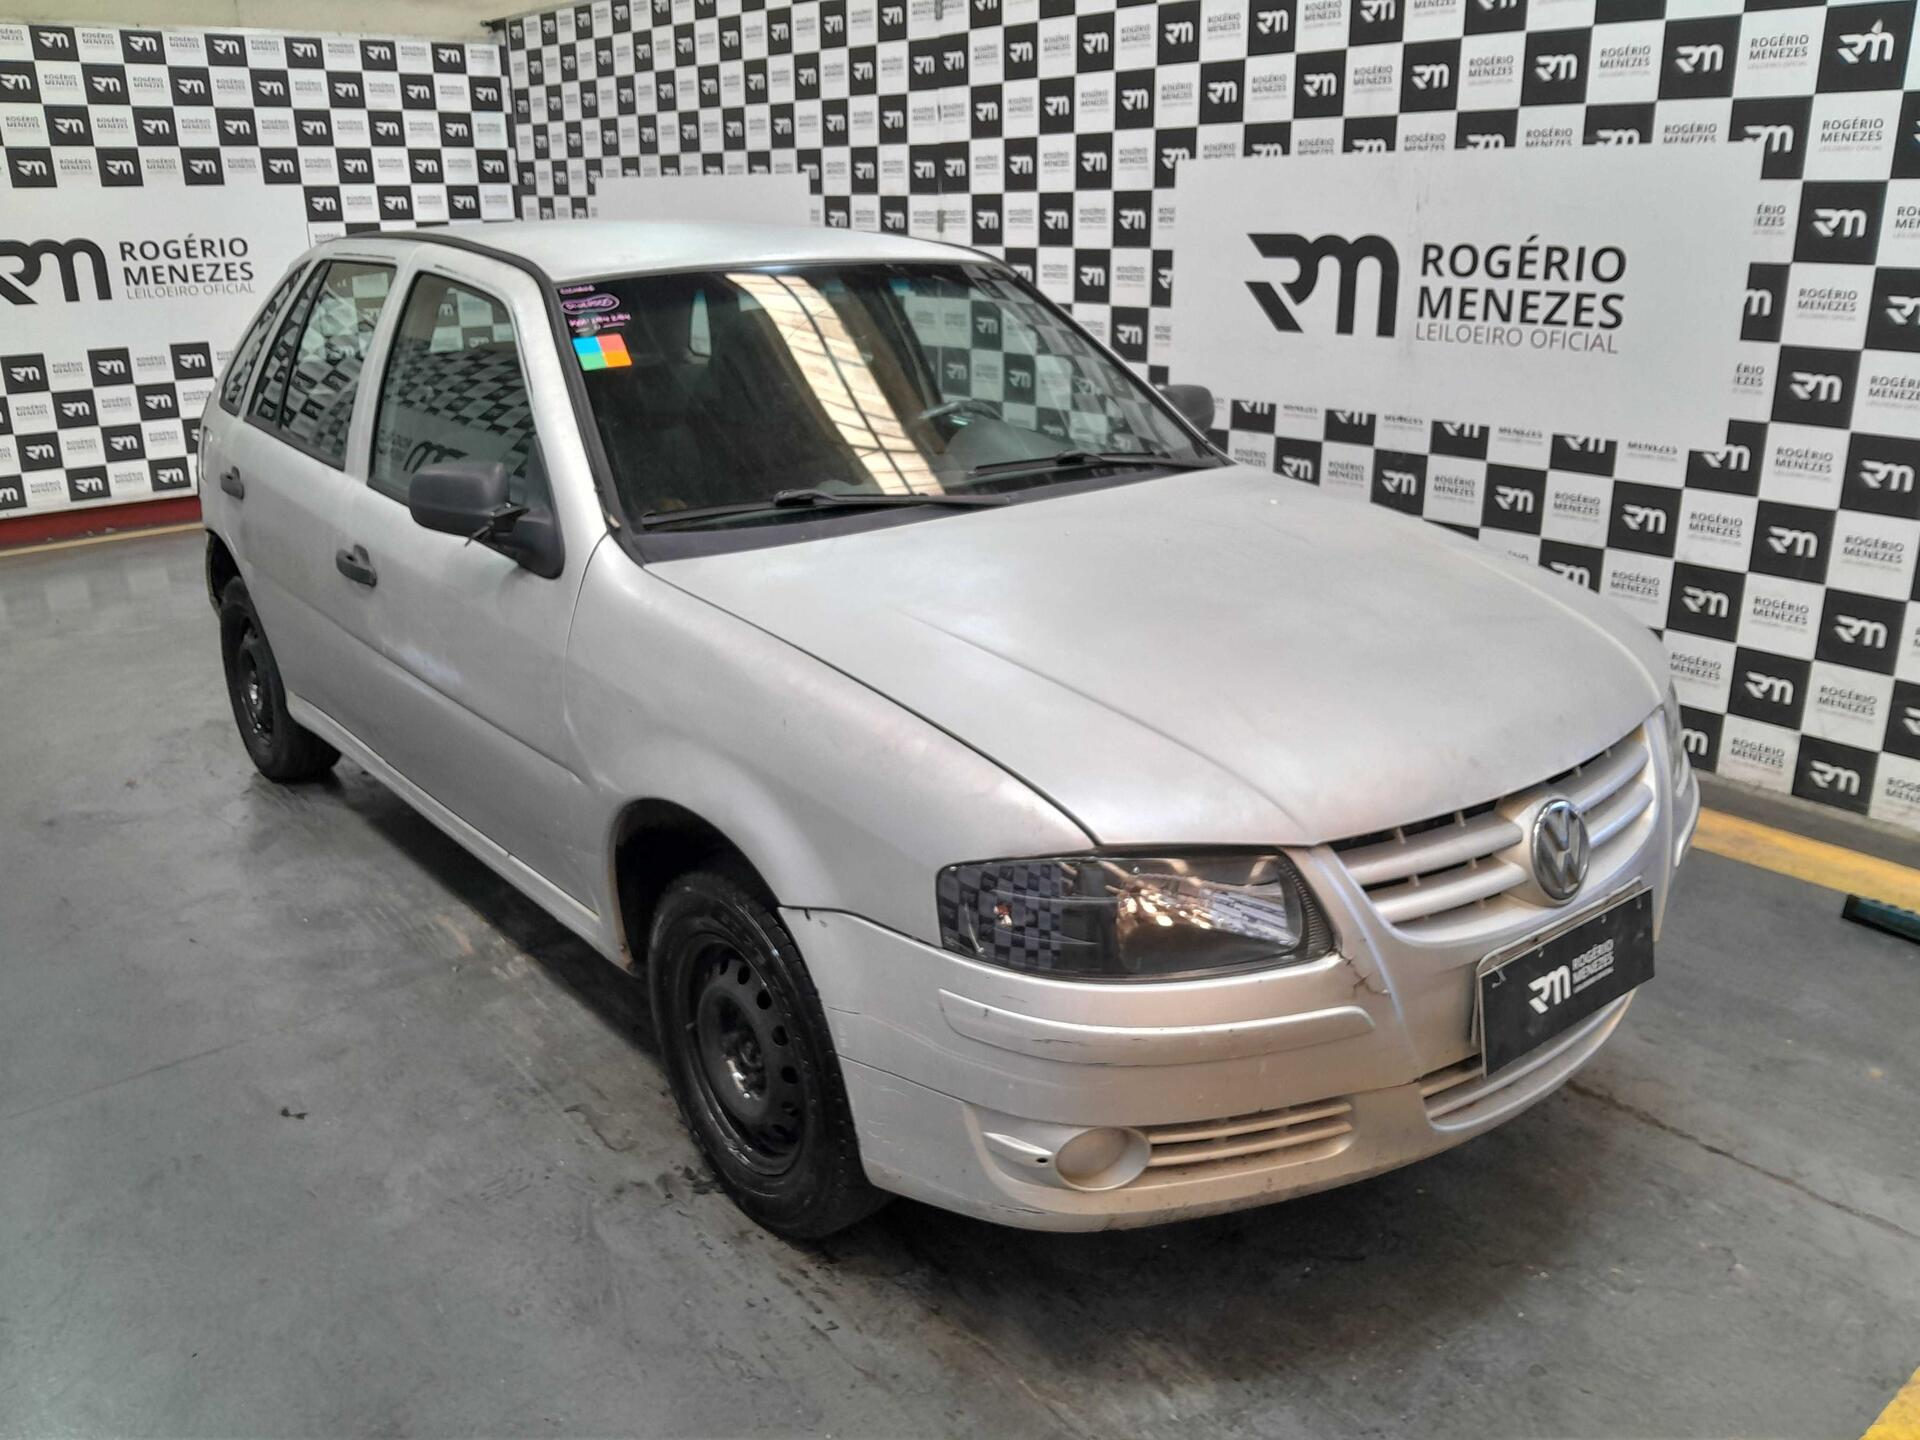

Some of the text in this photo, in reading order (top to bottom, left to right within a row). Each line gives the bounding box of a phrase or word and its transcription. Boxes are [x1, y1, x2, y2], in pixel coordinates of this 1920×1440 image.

[1750, 33, 1809, 48] ROGÉRIO
[1600, 44, 1651, 57] ROGÉRIO
[1749, 47, 1808, 60] MENEZES
[1468, 54, 1514, 67] ROGÉRIO
[1599, 56, 1650, 69] MENEZES
[1353, 64, 1393, 76] ROGÉRIO
[1467, 65, 1513, 78] MENEZES
[1352, 74, 1392, 86] MENEZES
[1664, 121, 1717, 134] ROGÉRIO
[1822, 117, 1884, 130] ROGÉRIO
[1525, 126, 1573, 138] ROGÉRIO
[1820, 130, 1882, 142] MENEZES
[1756, 204, 1786, 216] ÉRIO
[1755, 216, 1785, 226] EZES
[119, 233, 249, 261] ROGÉRIO
[1421, 234, 1627, 283] ROGÉRIO
[123, 261, 254, 286] MENEZES
[126, 282, 256, 300] LEILOEIRO OFICIAL
[1799, 287, 1858, 300] ROGÉRIO
[1417, 286, 1625, 329] MENEZES
[1797, 300, 1856, 311] MENEZES
[1415, 322, 1619, 354] LEILOEIRO OFICIAL
[1736, 363, 1765, 375] ÉRIO
[1735, 376, 1764, 387] EZES
[1867, 387, 1920, 400] MENEZE
[1776, 446, 1834, 462] ROGÉRIO
[1774, 458, 1832, 473] MENEZES
[1434, 474, 1475, 488] ROGÉRIO
[1433, 483, 1474, 497] MENEZES
[1554, 491, 1600, 506] ROGÉRIO
[1553, 500, 1599, 516] MENEZES
[1689, 511, 1743, 528] ROGÉRIO
[1688, 521, 1741, 538] MENEZES
[1753, 595, 1809, 615] ROGÉRIO
[1752, 606, 1808, 625] MENEZES
[1819, 683, 1878, 706] ROGÉRIO
[1817, 694, 1876, 717] MENEZES
